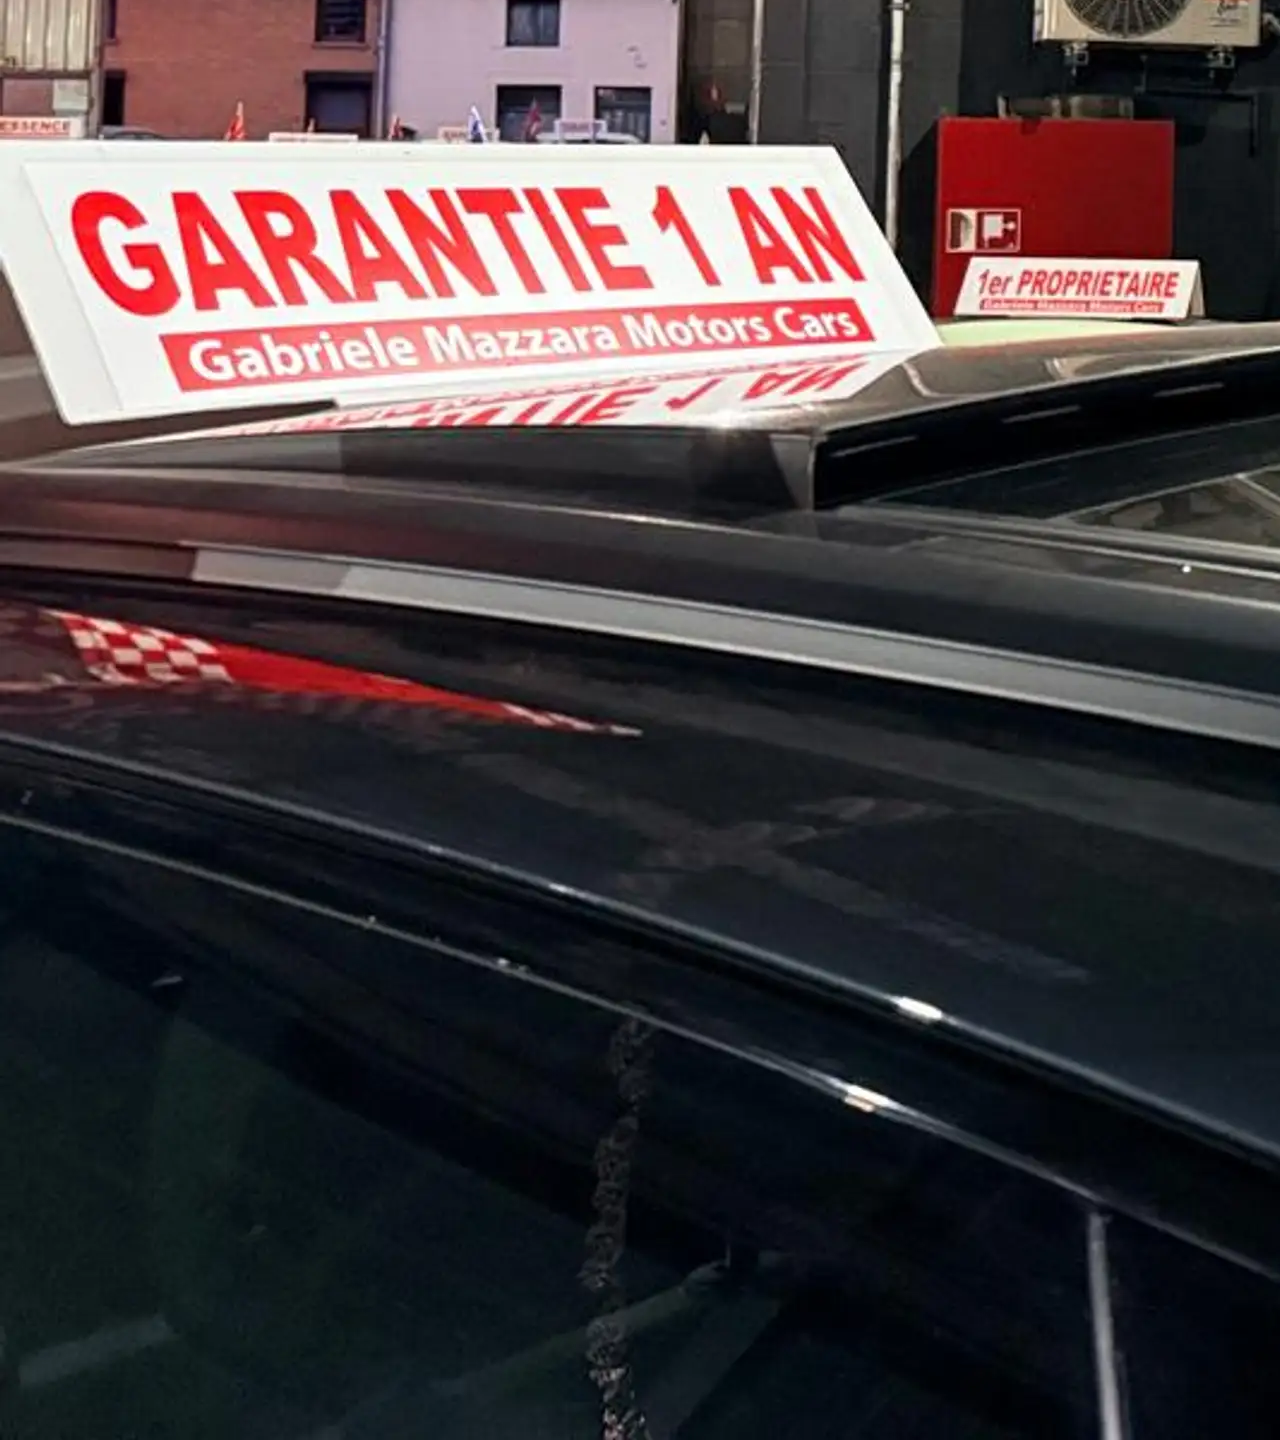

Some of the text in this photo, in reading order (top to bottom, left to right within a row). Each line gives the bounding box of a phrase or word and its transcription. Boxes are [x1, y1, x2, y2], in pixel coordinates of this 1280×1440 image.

[71, 185, 866, 317] GARANTIE 1 AN
[978, 269, 1179, 298] 1er PROPRIETAIRE
[188, 307, 859, 382] Gabriele Mazzara Motors Cars
